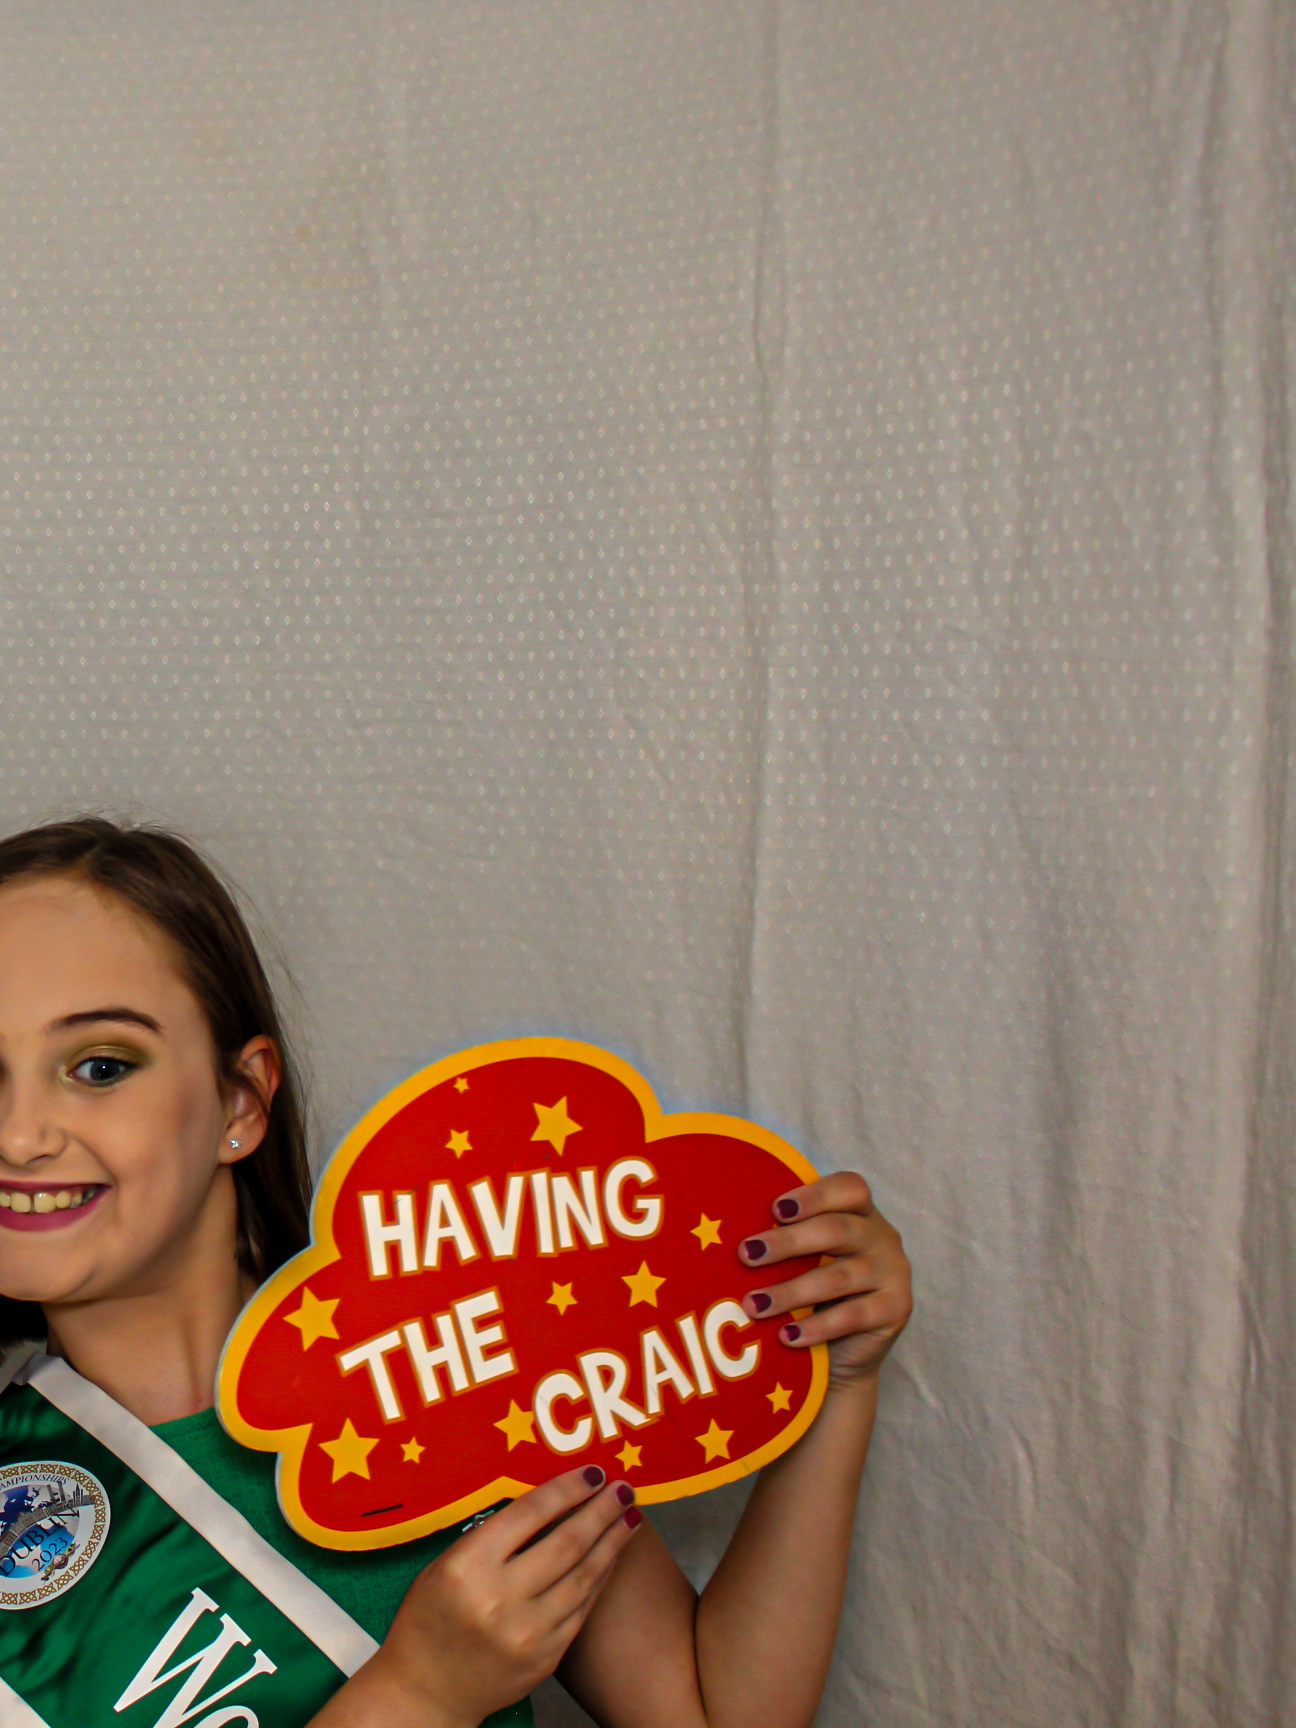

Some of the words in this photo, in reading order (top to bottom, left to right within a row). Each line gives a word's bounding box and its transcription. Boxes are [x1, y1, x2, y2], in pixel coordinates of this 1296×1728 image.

[362, 1159, 661, 1276] HAVING
[339, 1290, 514, 1420] THE
[534, 1300, 759, 1453] CRAIC
[31, 1536, 69, 1571] 2023
